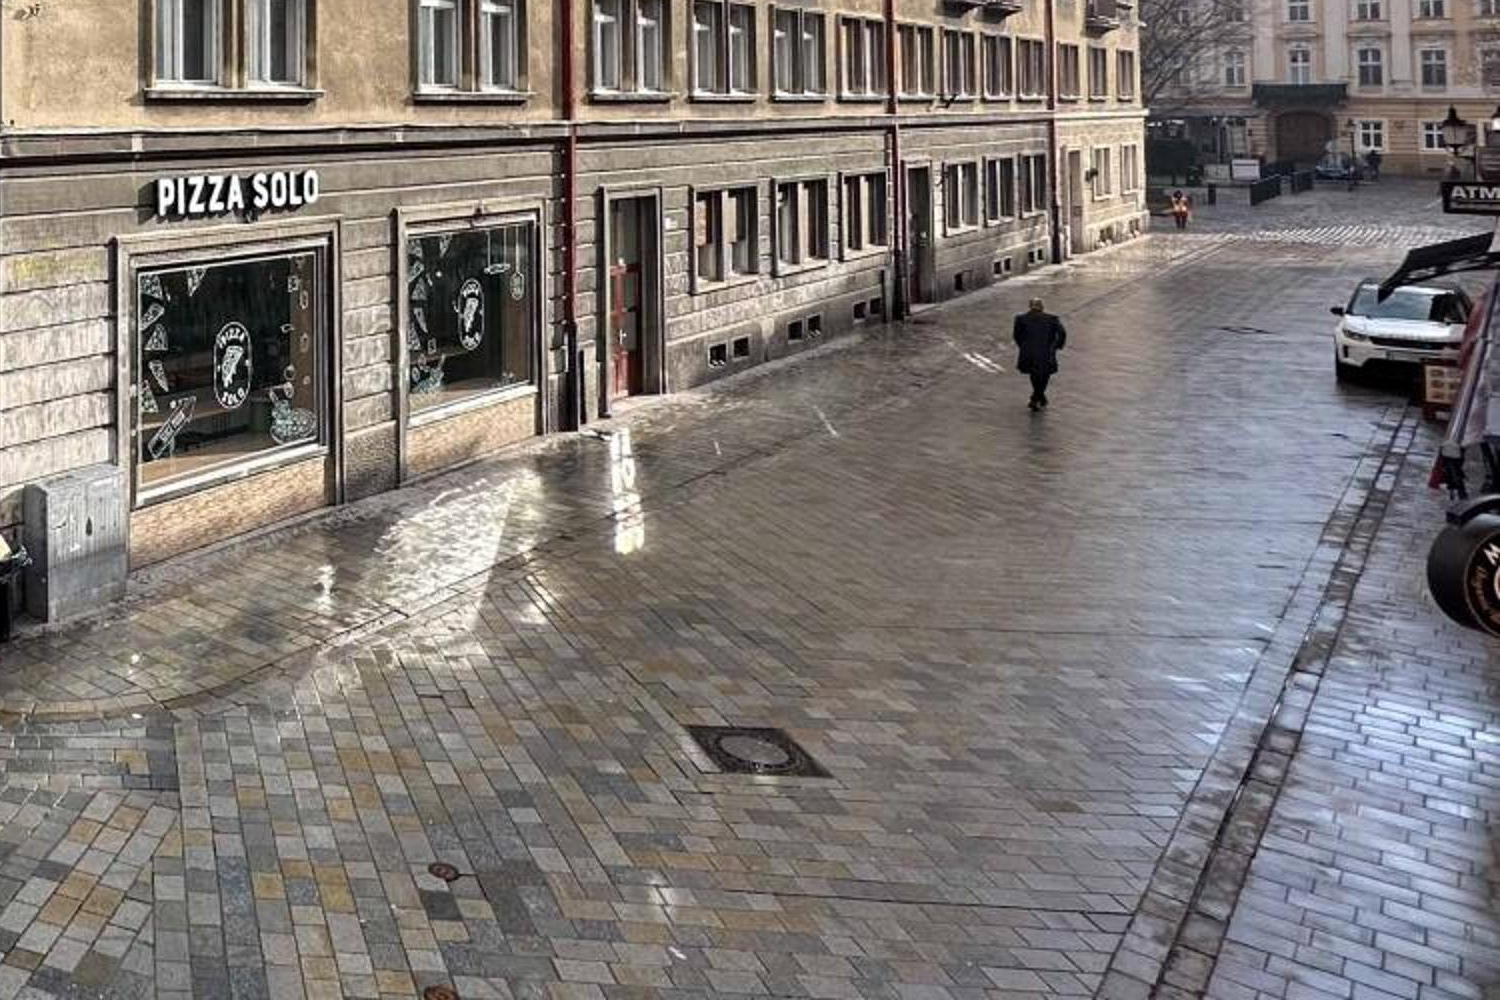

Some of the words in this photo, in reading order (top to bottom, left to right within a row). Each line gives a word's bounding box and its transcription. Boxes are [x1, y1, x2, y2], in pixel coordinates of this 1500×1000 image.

[157, 174, 245, 217] PIZZA
[252, 169, 319, 208] SOLO
[1451, 185, 1500, 199] ATM
[219, 328, 244, 348] PIZZA
